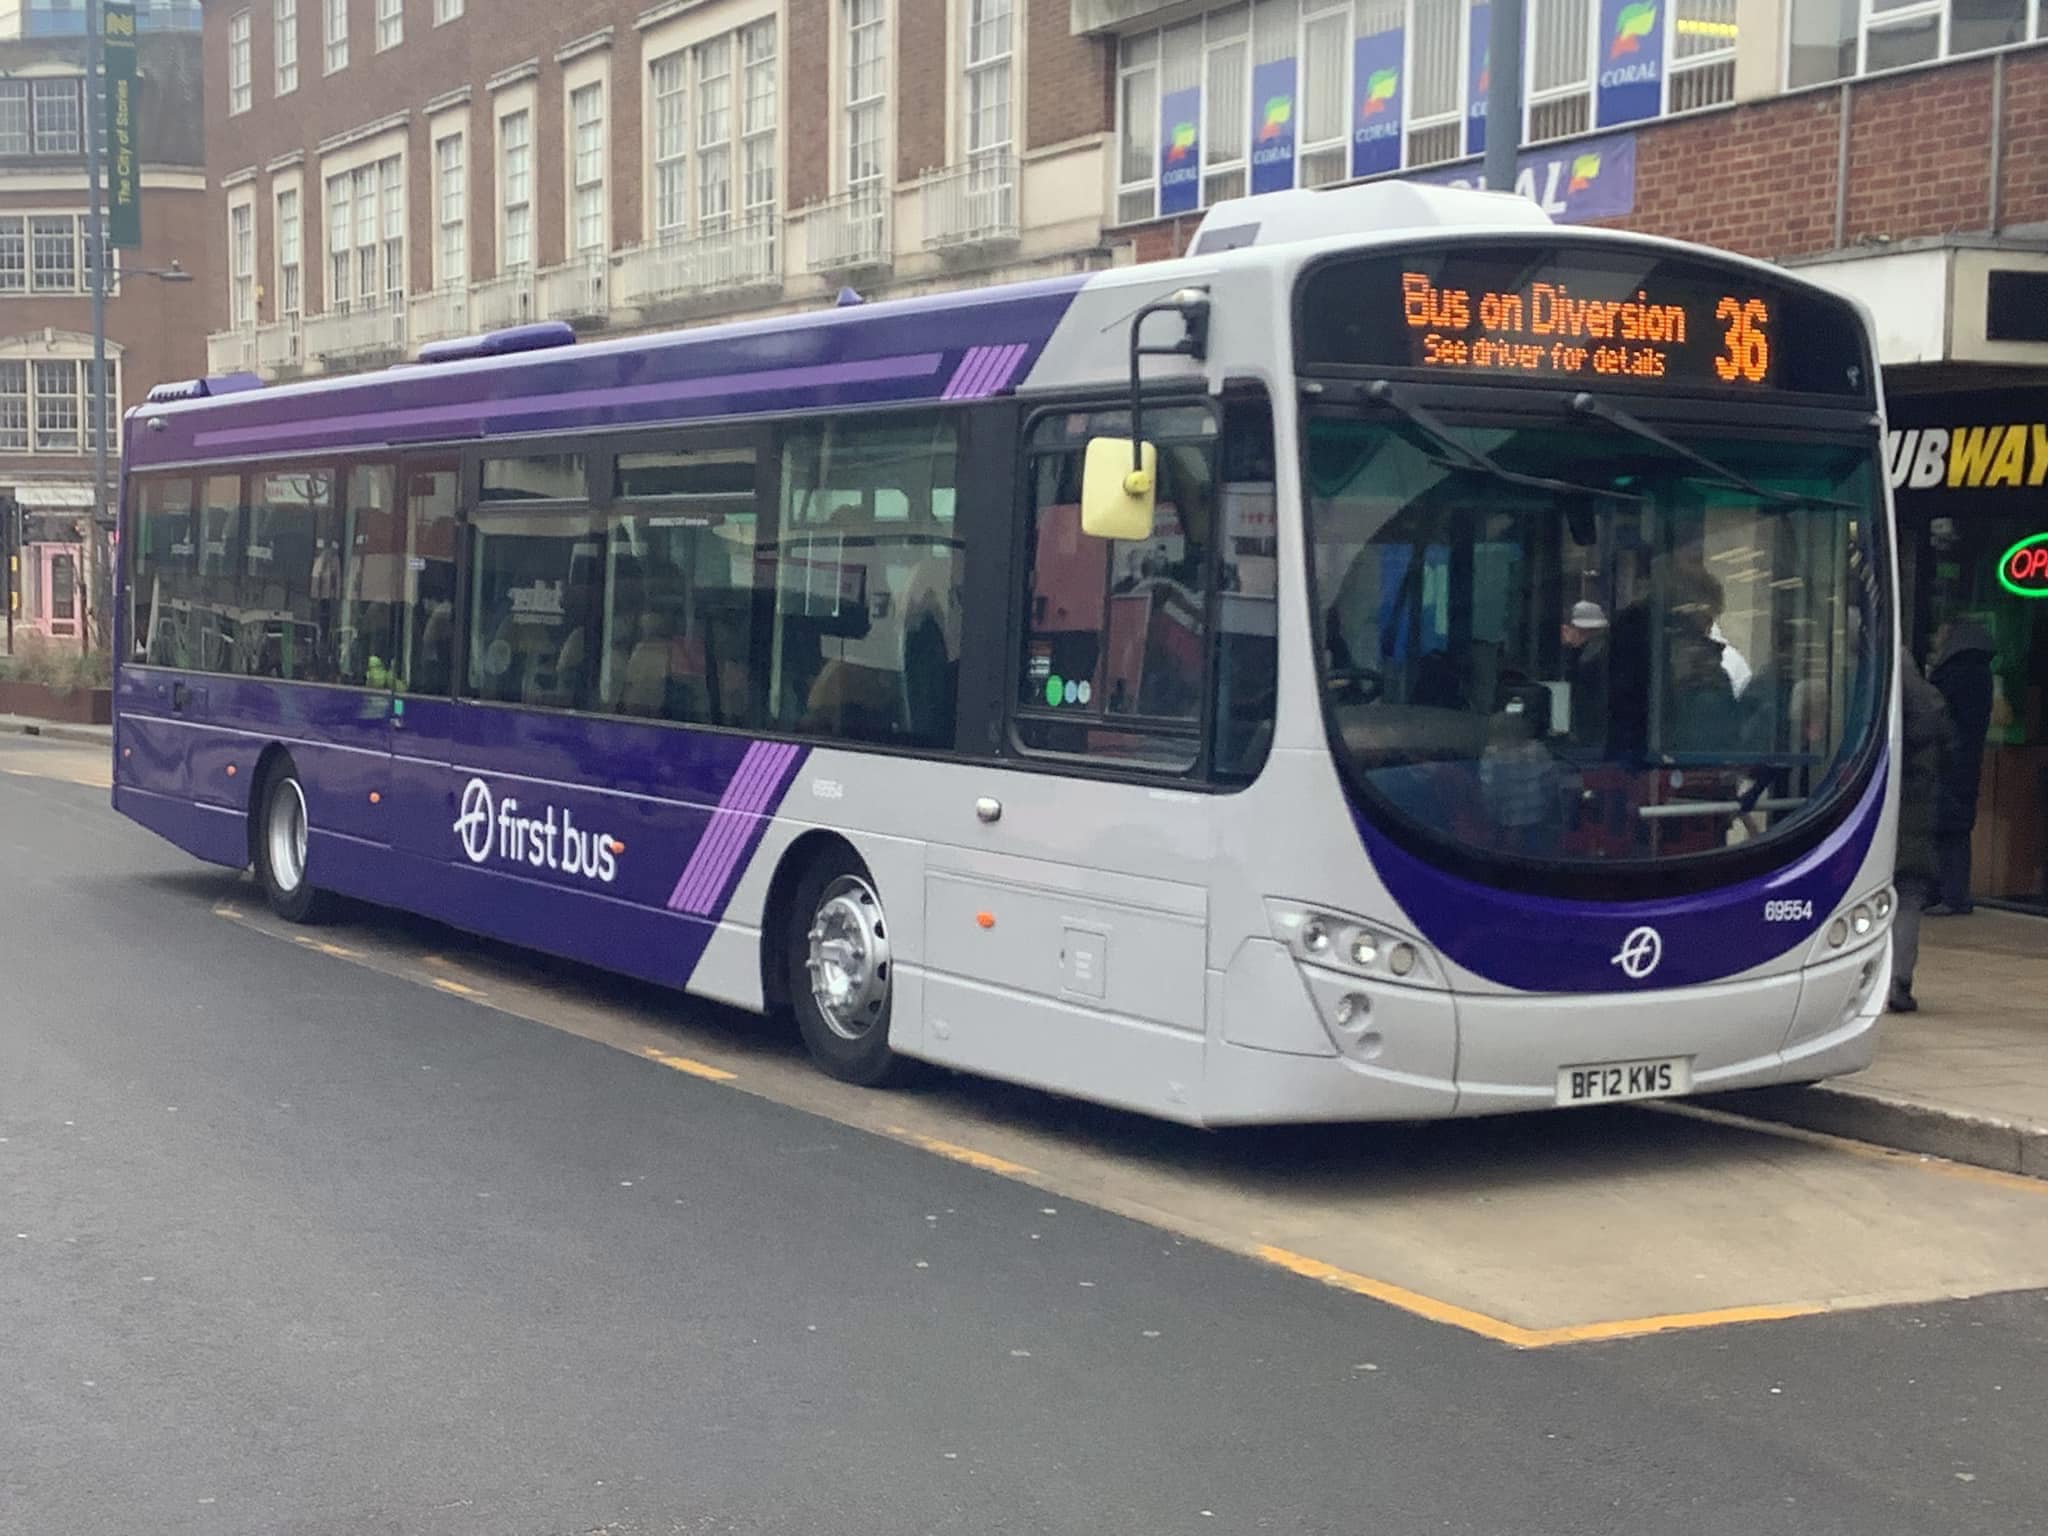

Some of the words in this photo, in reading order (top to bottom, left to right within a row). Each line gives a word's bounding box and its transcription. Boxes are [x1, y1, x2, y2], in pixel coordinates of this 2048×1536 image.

[1601, 61, 1657, 89] CORAL
[116, 128, 129, 145] of
[1355, 120, 1399, 144] CORAL
[118, 146, 133, 176] City
[1253, 144, 1292, 165] CORAL
[1162, 166, 1198, 186] CORAL
[118, 179, 131, 205] The
[1402, 272, 1470, 330] Bus
[1479, 290, 1522, 332] on
[1532, 281, 1686, 343] Diversion
[1714, 296, 1769, 382] 36
[1423, 333, 1468, 365] See
[1472, 337, 1545, 370] driver
[1550, 341, 1588, 372] for
[1594, 344, 1666, 378] details
[1885, 423, 2048, 489] UBWAY
[2011, 548, 2048, 579] OP
[498, 797, 558, 869] first
[561, 807, 616, 882] bus
[1764, 899, 1814, 922] 69554
[1571, 1069, 1622, 1099] BF12
[1628, 1064, 1672, 1095] KWS
